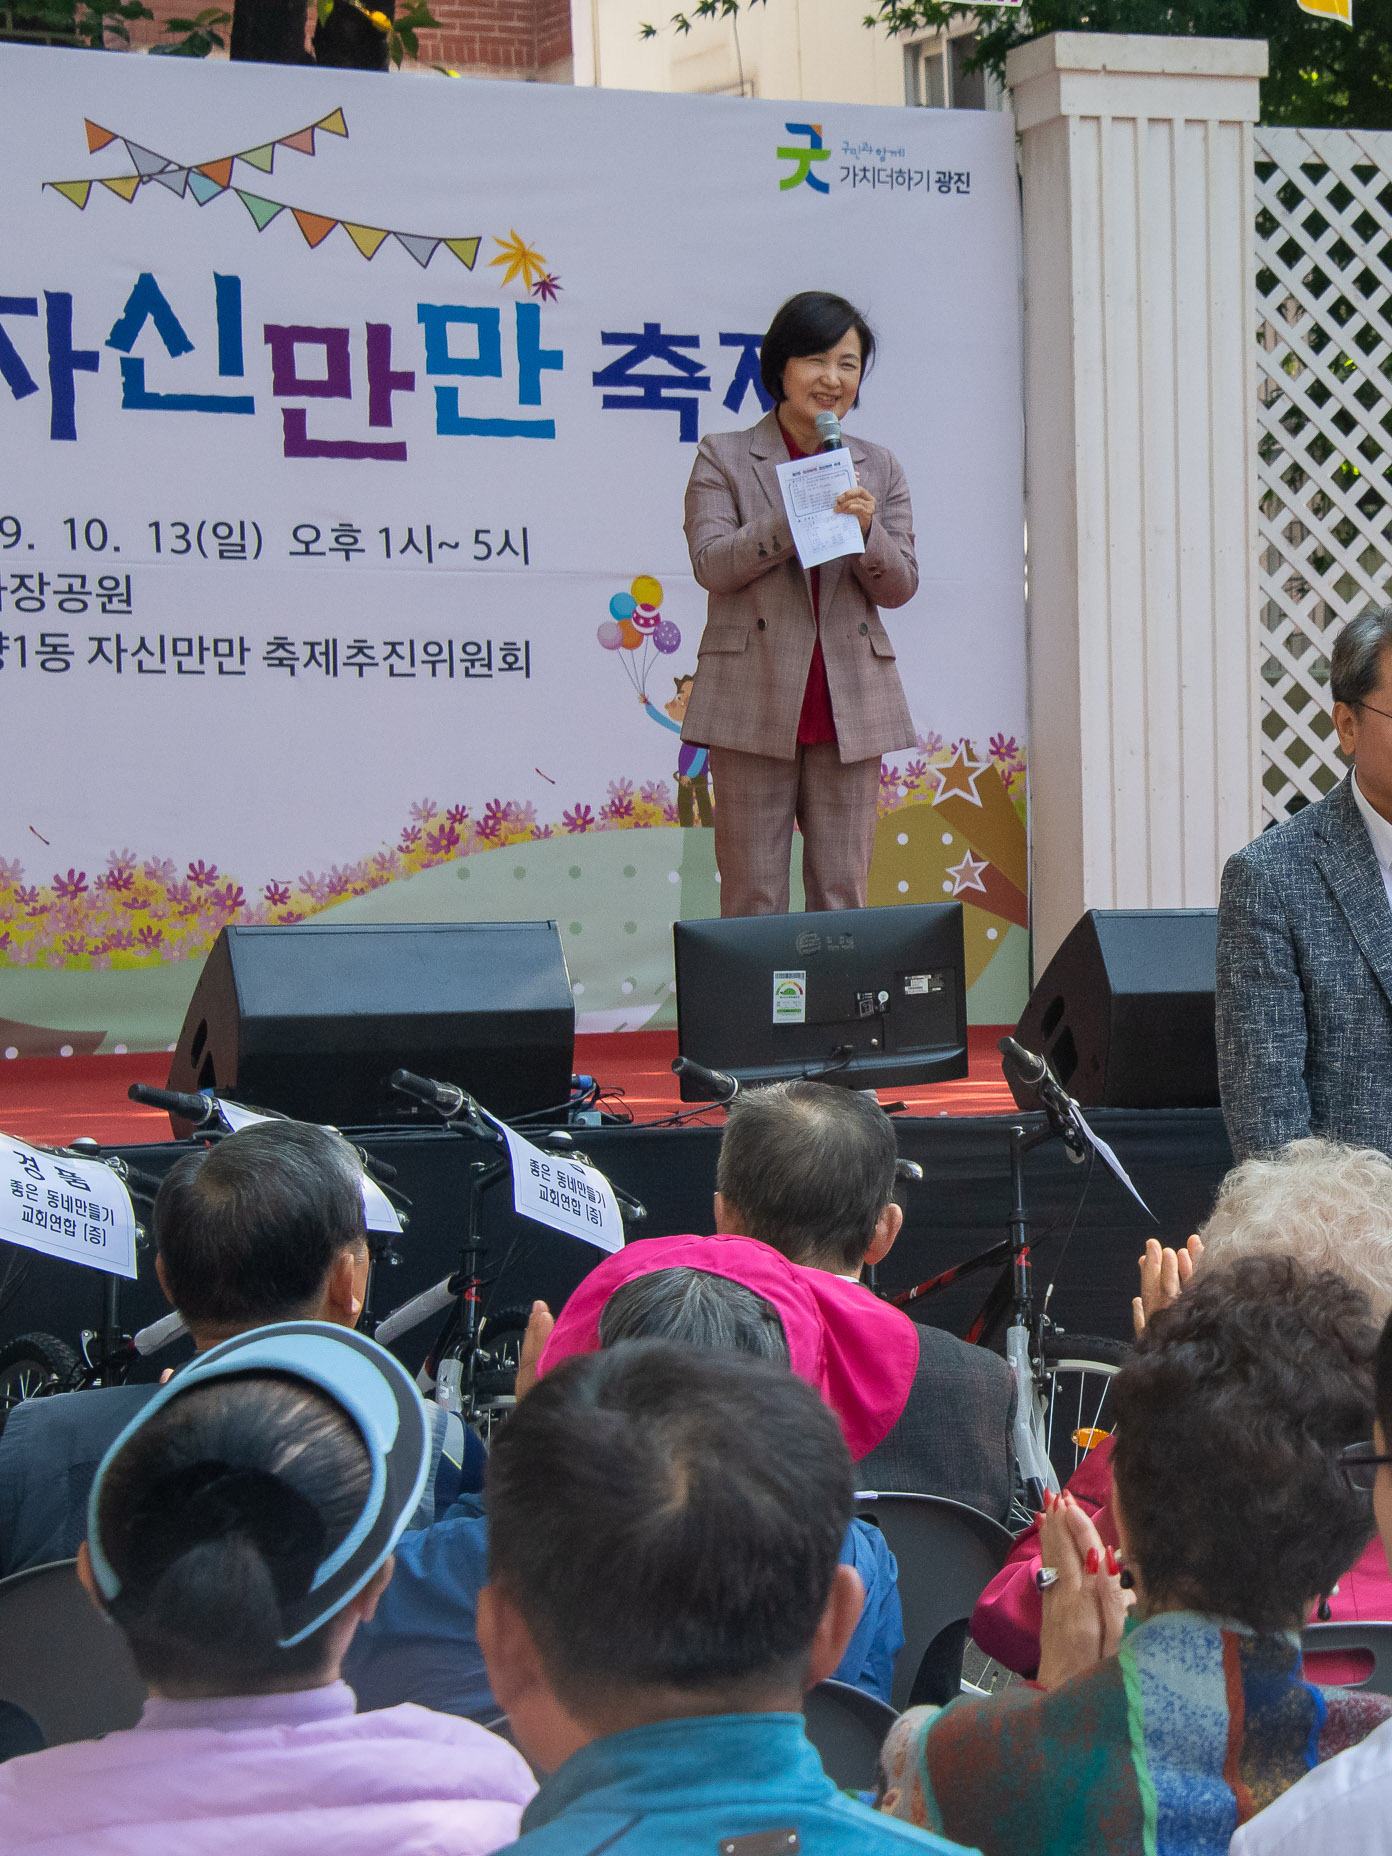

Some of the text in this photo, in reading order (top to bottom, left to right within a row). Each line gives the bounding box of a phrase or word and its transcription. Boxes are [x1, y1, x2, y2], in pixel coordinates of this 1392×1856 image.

[840, 165, 971, 194] 가치더하기 광진
[63, 517, 121, 552] 10.
[147, 519, 263, 561] 13(일)
[288, 522, 366, 562] 오후
[473, 526, 531, 566] 5시
[0, 571, 133, 615] 장공원
[87, 633, 250, 677] 자신만만
[262, 635, 532, 679] 축제추진위원회
[10, 1179, 115, 1227] 좋은 동네만들기
[529, 1158, 551, 1182] 좋은
[556, 1169, 606, 1208] 동네만들기
[538, 1183, 582, 1217] 교회연합
[21, 1204, 77, 1238] 교회연합
